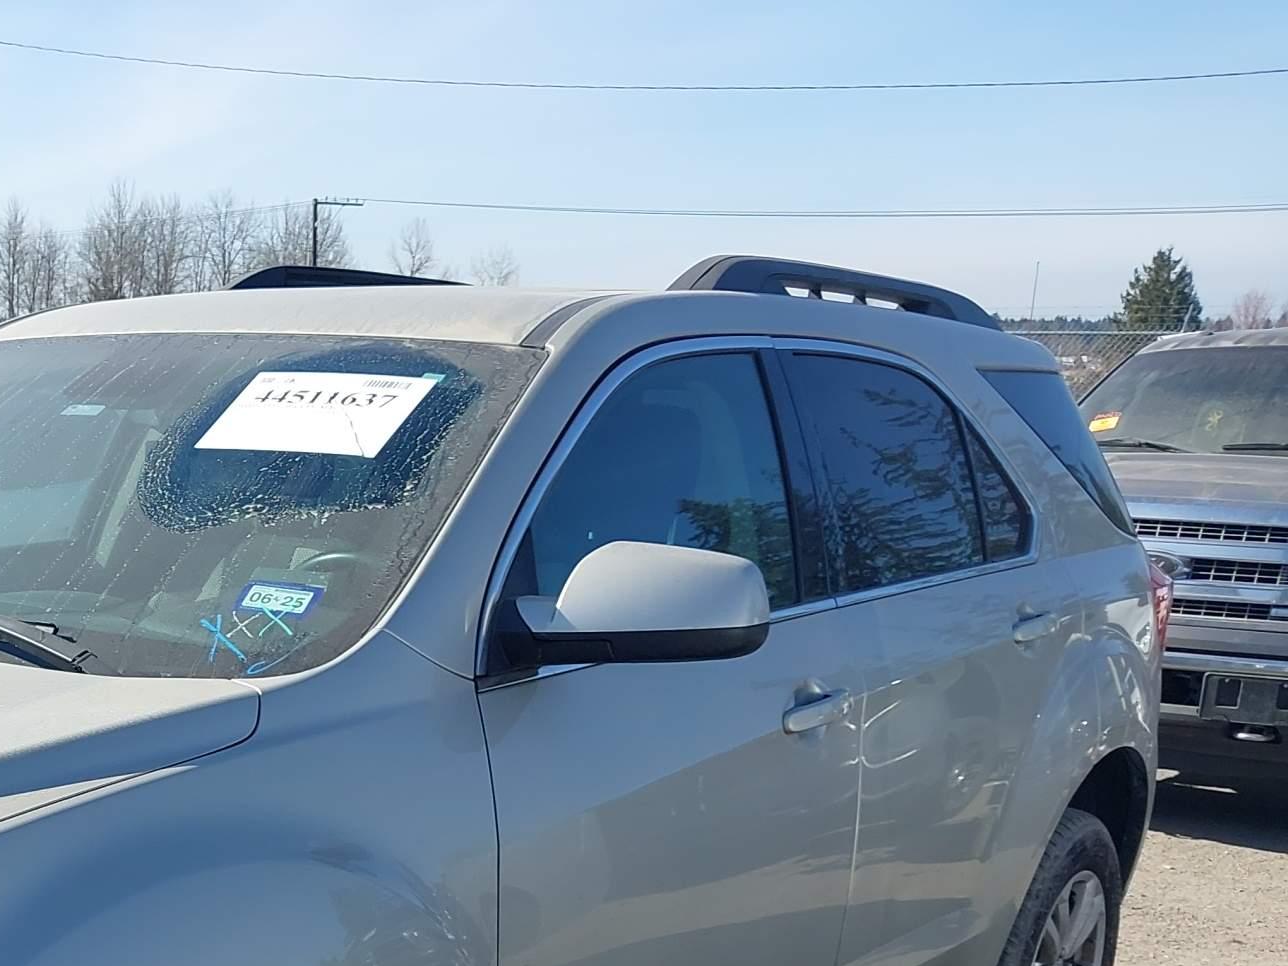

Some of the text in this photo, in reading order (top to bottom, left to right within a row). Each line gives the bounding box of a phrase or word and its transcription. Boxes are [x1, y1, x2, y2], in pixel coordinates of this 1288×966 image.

[255, 389, 400, 408] 44511637
[249, 591, 275, 605] 06
[280, 595, 307, 609] 25
